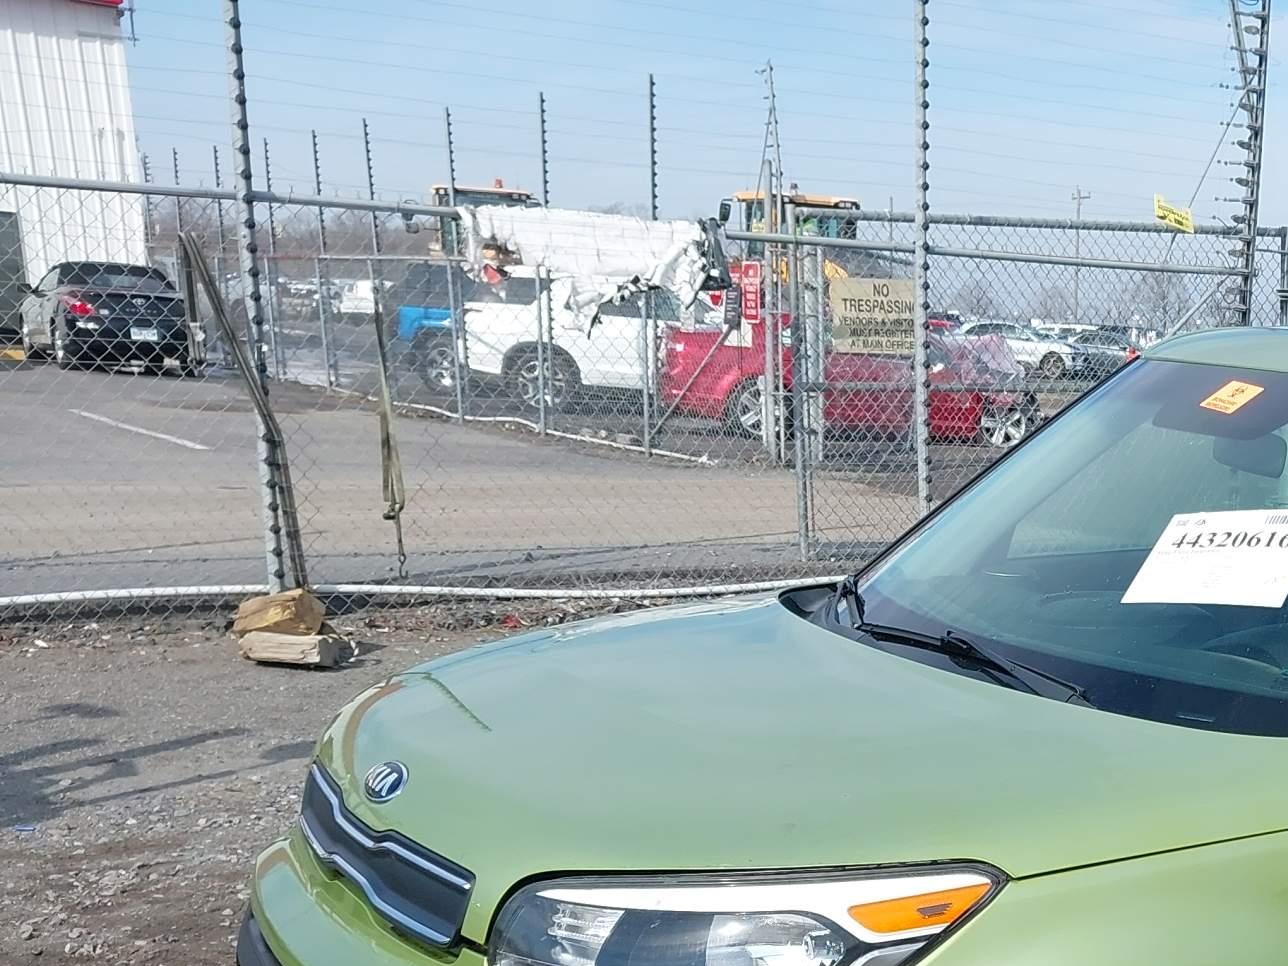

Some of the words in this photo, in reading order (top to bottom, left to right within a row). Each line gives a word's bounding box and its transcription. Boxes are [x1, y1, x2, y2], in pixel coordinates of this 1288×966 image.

[872, 283, 890, 298] NO
[841, 297, 915, 314] TRESPASSIN
[862, 338, 884, 349] MAIN
[884, 339, 915, 351] OFFICE
